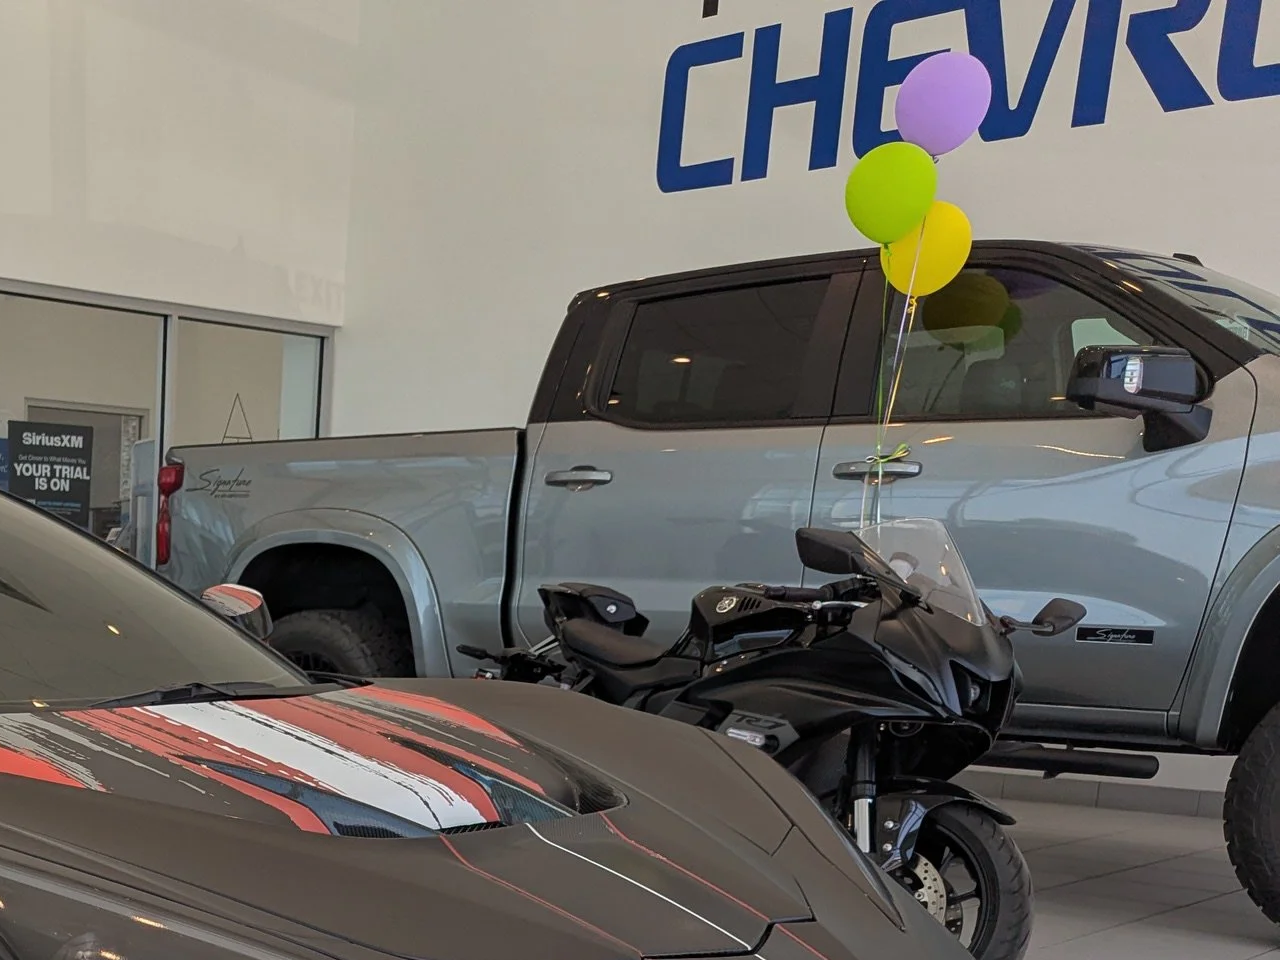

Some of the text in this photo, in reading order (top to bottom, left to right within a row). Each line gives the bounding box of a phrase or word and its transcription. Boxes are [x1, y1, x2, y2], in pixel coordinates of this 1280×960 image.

[656, 0, 1280, 194] CHEVR
[22, 432, 84, 449] SiriusXM
[13, 462, 91, 481] YOUR TRIAL
[34, 477, 70, 492] IS ON
[185, 468, 252, 496] Signature
